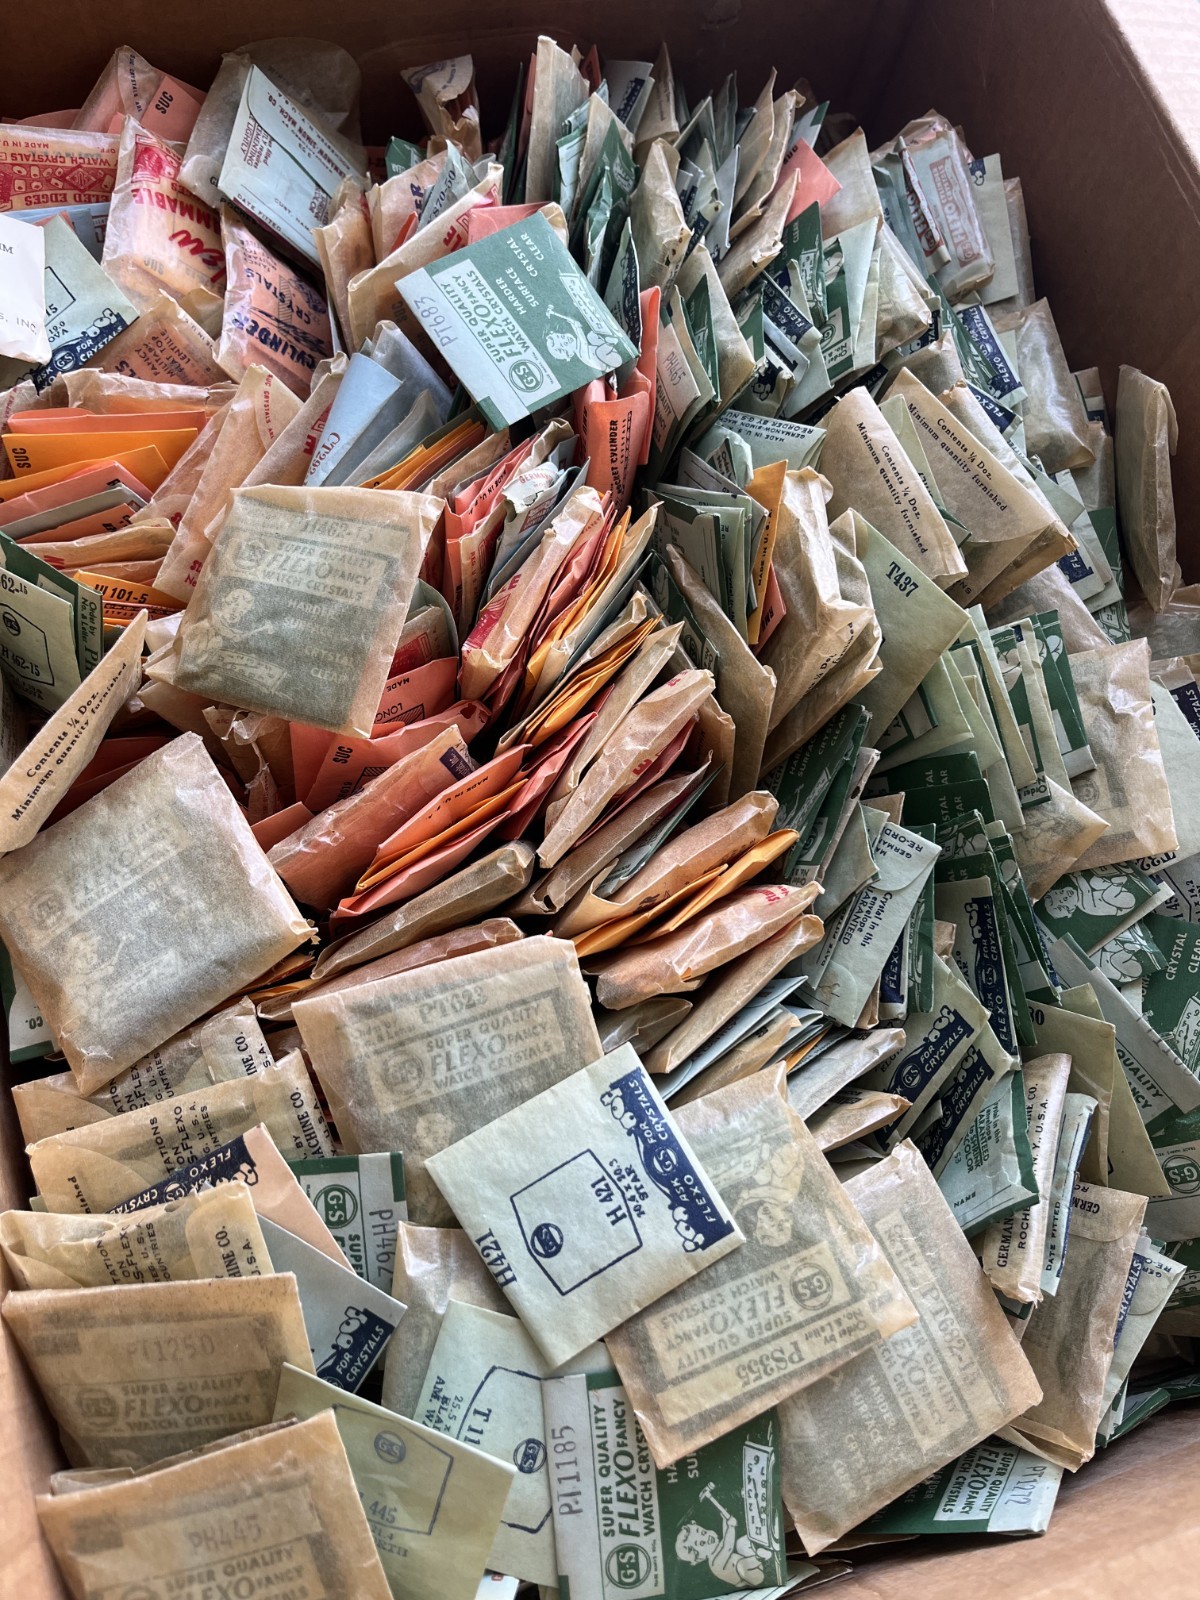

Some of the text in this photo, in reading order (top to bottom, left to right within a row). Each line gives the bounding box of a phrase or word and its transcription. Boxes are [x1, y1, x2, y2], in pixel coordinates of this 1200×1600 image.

[155, 91, 173, 115] SUC
[267, 93, 276, 107] CO.
[11, 153, 110, 167] WATCH CRYSTALS
[25, 194, 67, 206] EDGES
[237, 193, 255, 213] DATE
[258, 211, 282, 231] FITTED
[506, 237, 538, 278] CRYSTAL
[520, 232, 545, 261] CLEAR
[245, 267, 311, 325] CRYSTALS
[495, 276, 528, 316] HARDER
[505, 266, 540, 308] SURFACE
[16, 317, 37, 335] INC.
[440, 282, 506, 364] SUPER QUALITY
[451, 275, 522, 358] FLEXO FANCY
[465, 269, 531, 352] WATCH CRYSTALS
[783, 305, 806, 328] FLEXO
[968, 306, 990, 340] CRYSTALS
[36, 339, 93, 384] ASK FOR
[79, 326, 123, 363] CRYSTALS
[151, 335, 164, 352] TOP
[160, 328, 190, 365] LENTILLE
[665, 351, 686, 387] PH465
[993, 356, 1011, 383] FLEXO
[754, 431, 785, 442] MADE IN
[761, 417, 771, 426] BY
[11, 447, 32, 470] SUC
[609, 419, 619, 464] CYLINDER
[907, 403, 1008, 513] Minimum quantity furnished
[936, 417, 994, 482] Contents Doz.
[856, 421, 928, 555] Minimum quantity furnished
[880, 444, 922, 521] Contents Doz.
[261, 569, 363, 602] WATCH CRYSTALS
[757, 548, 767, 587] MADE IN
[884, 560, 919, 599] T437
[110, 587, 149, 604] 101-5
[80, 621, 90, 644] Letter
[88, 601, 98, 637] Order by
[386, 677, 410, 692] MADE
[11, 769, 54, 821] Minimum
[55, 718, 90, 766] quantity
[90, 662, 127, 714] furnished
[26, 730, 69, 778] Contents
[77, 691, 99, 715] Doz.
[332, 745, 354, 765] SUC
[466, 775, 489, 793] MADE
[856, 896, 877, 934] envelope
[860, 891, 893, 947] Crystal this
[985, 903, 997, 961] CRYSTALS
[1165, 932, 1188, 981] CRYSTAL
[25, 1017, 44, 1030] CO.
[425, 1030, 473, 1052] SUPER
[478, 1003, 541, 1034] QUALITY
[998, 994, 1008, 1042] FLEXO
[234, 1031, 249, 1053] CO.
[430, 1023, 549, 1076] FLEXO FANCY
[920, 1044, 935, 1065] FOR
[924, 1025, 964, 1074] CRYSTALS
[433, 1041, 552, 1090] WATCH CRYSTALS
[1116, 1048, 1164, 1099] QUALITY
[952, 1083, 964, 1102] FOR
[954, 1066, 985, 1116] CRYSTALS
[170, 1145, 186, 1165] ON
[293, 1134, 304, 1149] BY
[627, 1079, 716, 1223] FLEXO CRYSTALS
[189, 1147, 232, 1178] FLEXO
[638, 1121, 691, 1203] ASK FOR
[590, 1176, 628, 1226] H 421
[624, 1164, 649, 1202] STAR
[953, 1191, 977, 1209] NAME
[215, 1225, 231, 1248] CO.
[1045, 1200, 1061, 1272] DATE FITTED
[474, 1227, 518, 1288] H421
[660, 1270, 779, 1329] WATCH CRYSTALS
[667, 1284, 786, 1352] FLEXO FANCY
[345, 1324, 385, 1383] CRYSTALS
[676, 1312, 792, 1372] SUPER QUALITY
[335, 1351, 355, 1376] FOR
[735, 1346, 807, 1389] PS355
[120, 1376, 244, 1396] SUPER QUALITY
[427, 1375, 446, 1403] AM.
[124, 1394, 206, 1420] FLEXO
[127, 1412, 251, 1433] WATCH CRYSTALS
[449, 1395, 464, 1420] 25.5
[472, 1407, 492, 1425] T
[593, 1404, 616, 1538] SUPER QUALITY
[612, 1398, 641, 1539] FLEXO FANCY
[958, 1450, 1000, 1515] FLEXO FANCY
[980, 1451, 1015, 1514] SUPER QUALITY
[639, 1480, 655, 1537] WATCH
[941, 1472, 961, 1514] CRYSTALS
[368, 1501, 398, 1524] 445
[165, 1546, 295, 1593] SUPER QUALITY
[255, 1564, 305, 1589] FANCY
